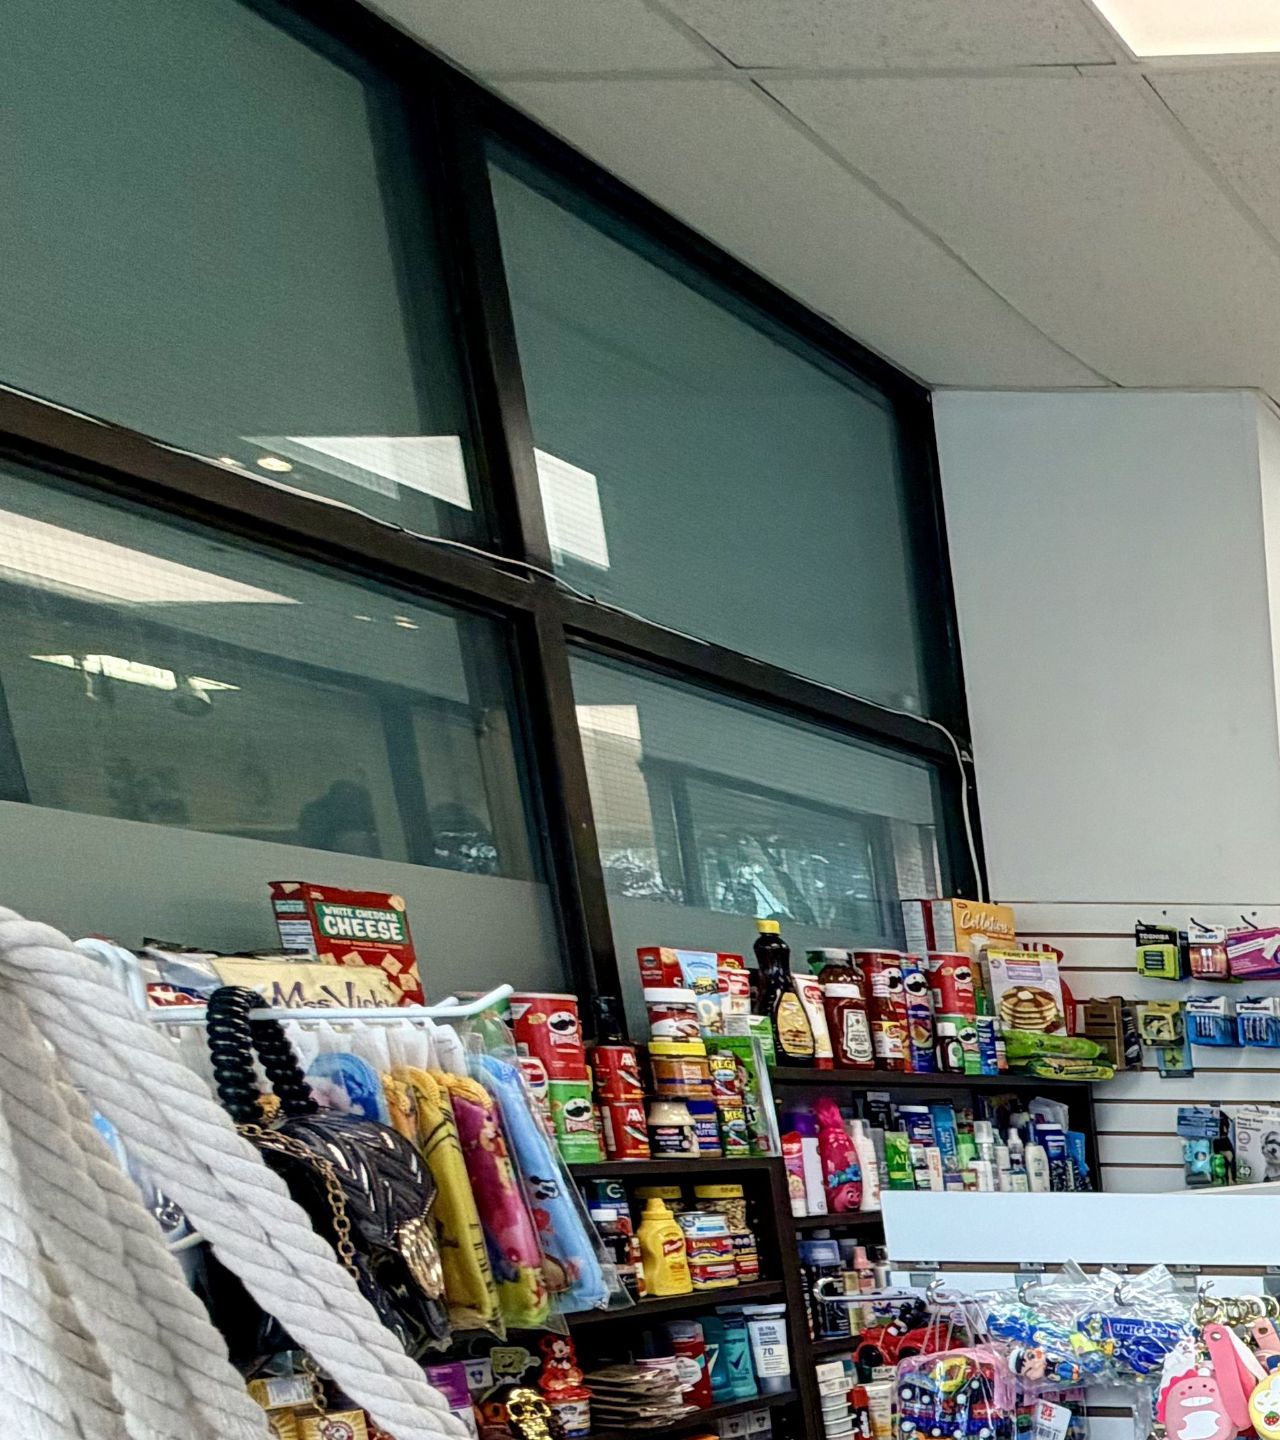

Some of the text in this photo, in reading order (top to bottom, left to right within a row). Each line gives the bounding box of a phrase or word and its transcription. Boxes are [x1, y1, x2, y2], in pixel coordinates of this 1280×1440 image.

[322, 905, 353, 918] WHITE
[322, 917, 403, 941] CHEESE
[762, 1347, 774, 1356] 70
